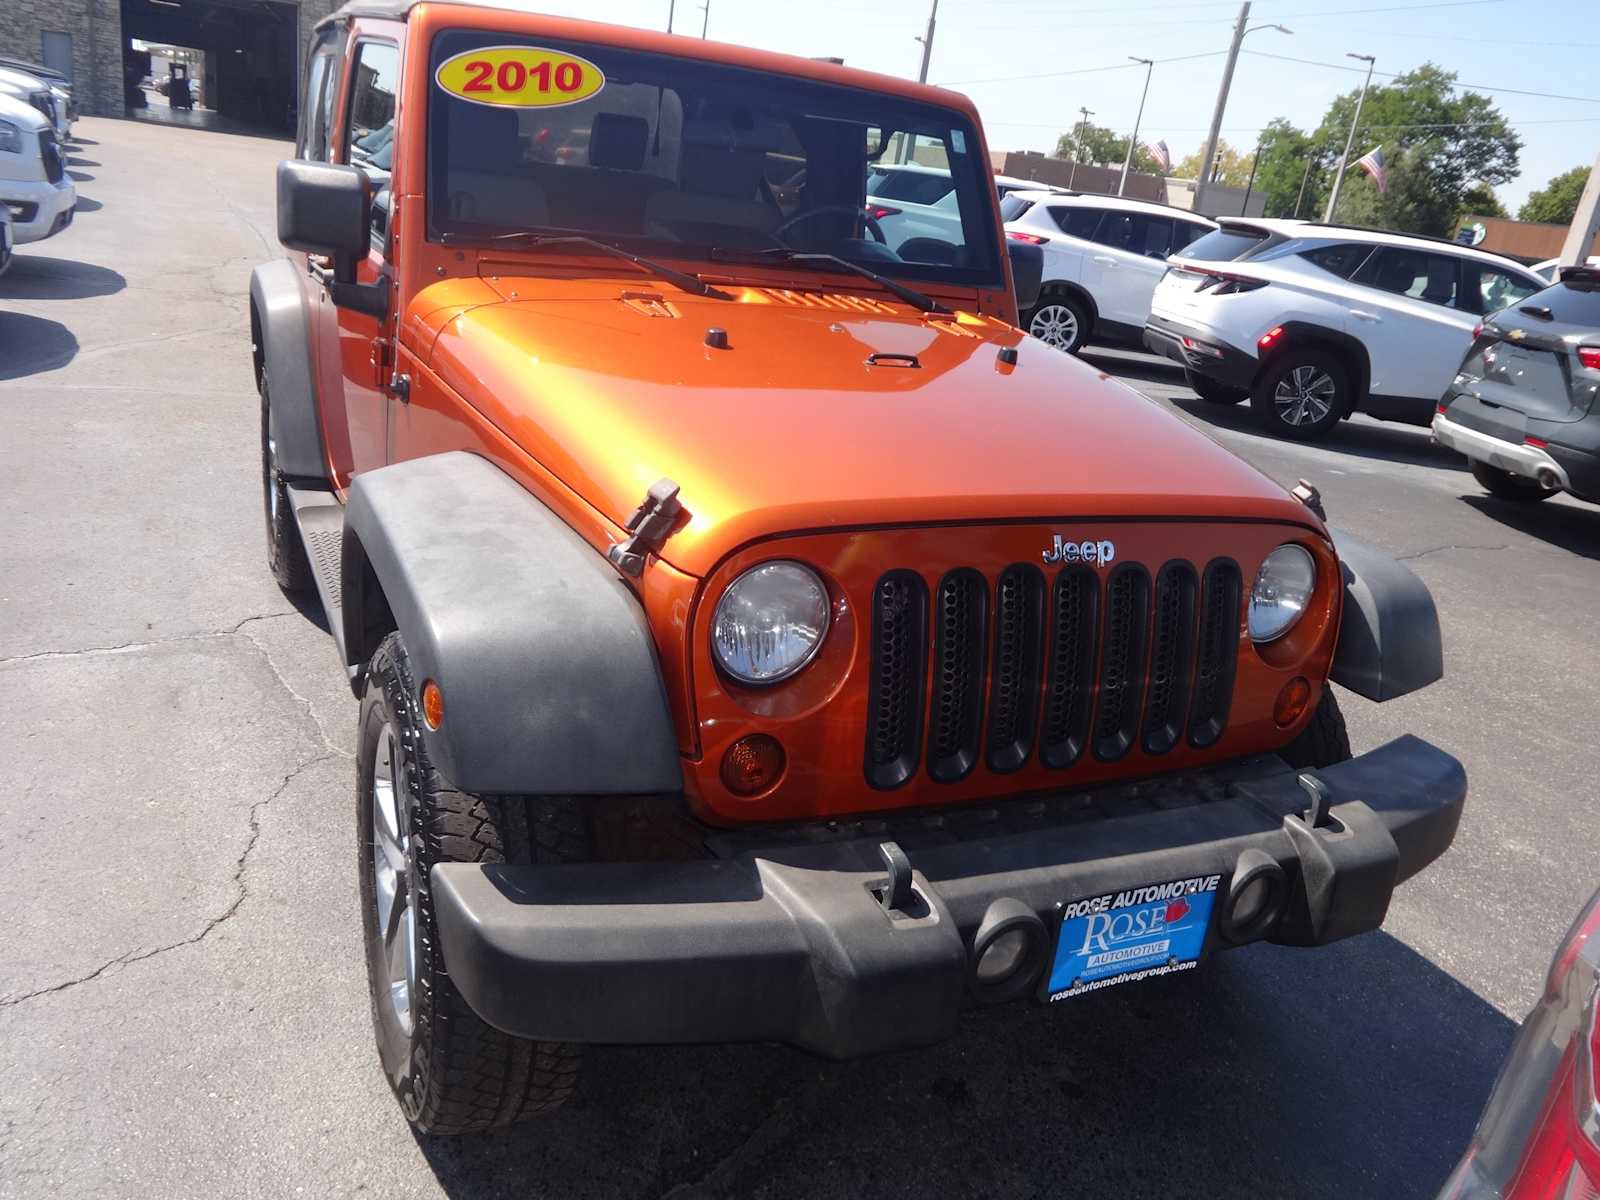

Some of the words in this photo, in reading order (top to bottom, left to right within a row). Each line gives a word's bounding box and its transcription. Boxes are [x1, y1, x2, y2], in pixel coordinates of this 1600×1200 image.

[462, 60, 583, 93] 2010
[1042, 534, 1115, 568] Jeep
[1111, 875, 1221, 910] AUTOMOTIVE
[1076, 906, 1168, 957] ROSE
[1092, 941, 1165, 967] AUTOMOTIVE
[1050, 960, 1198, 1002] roseautomotivegroup.com
